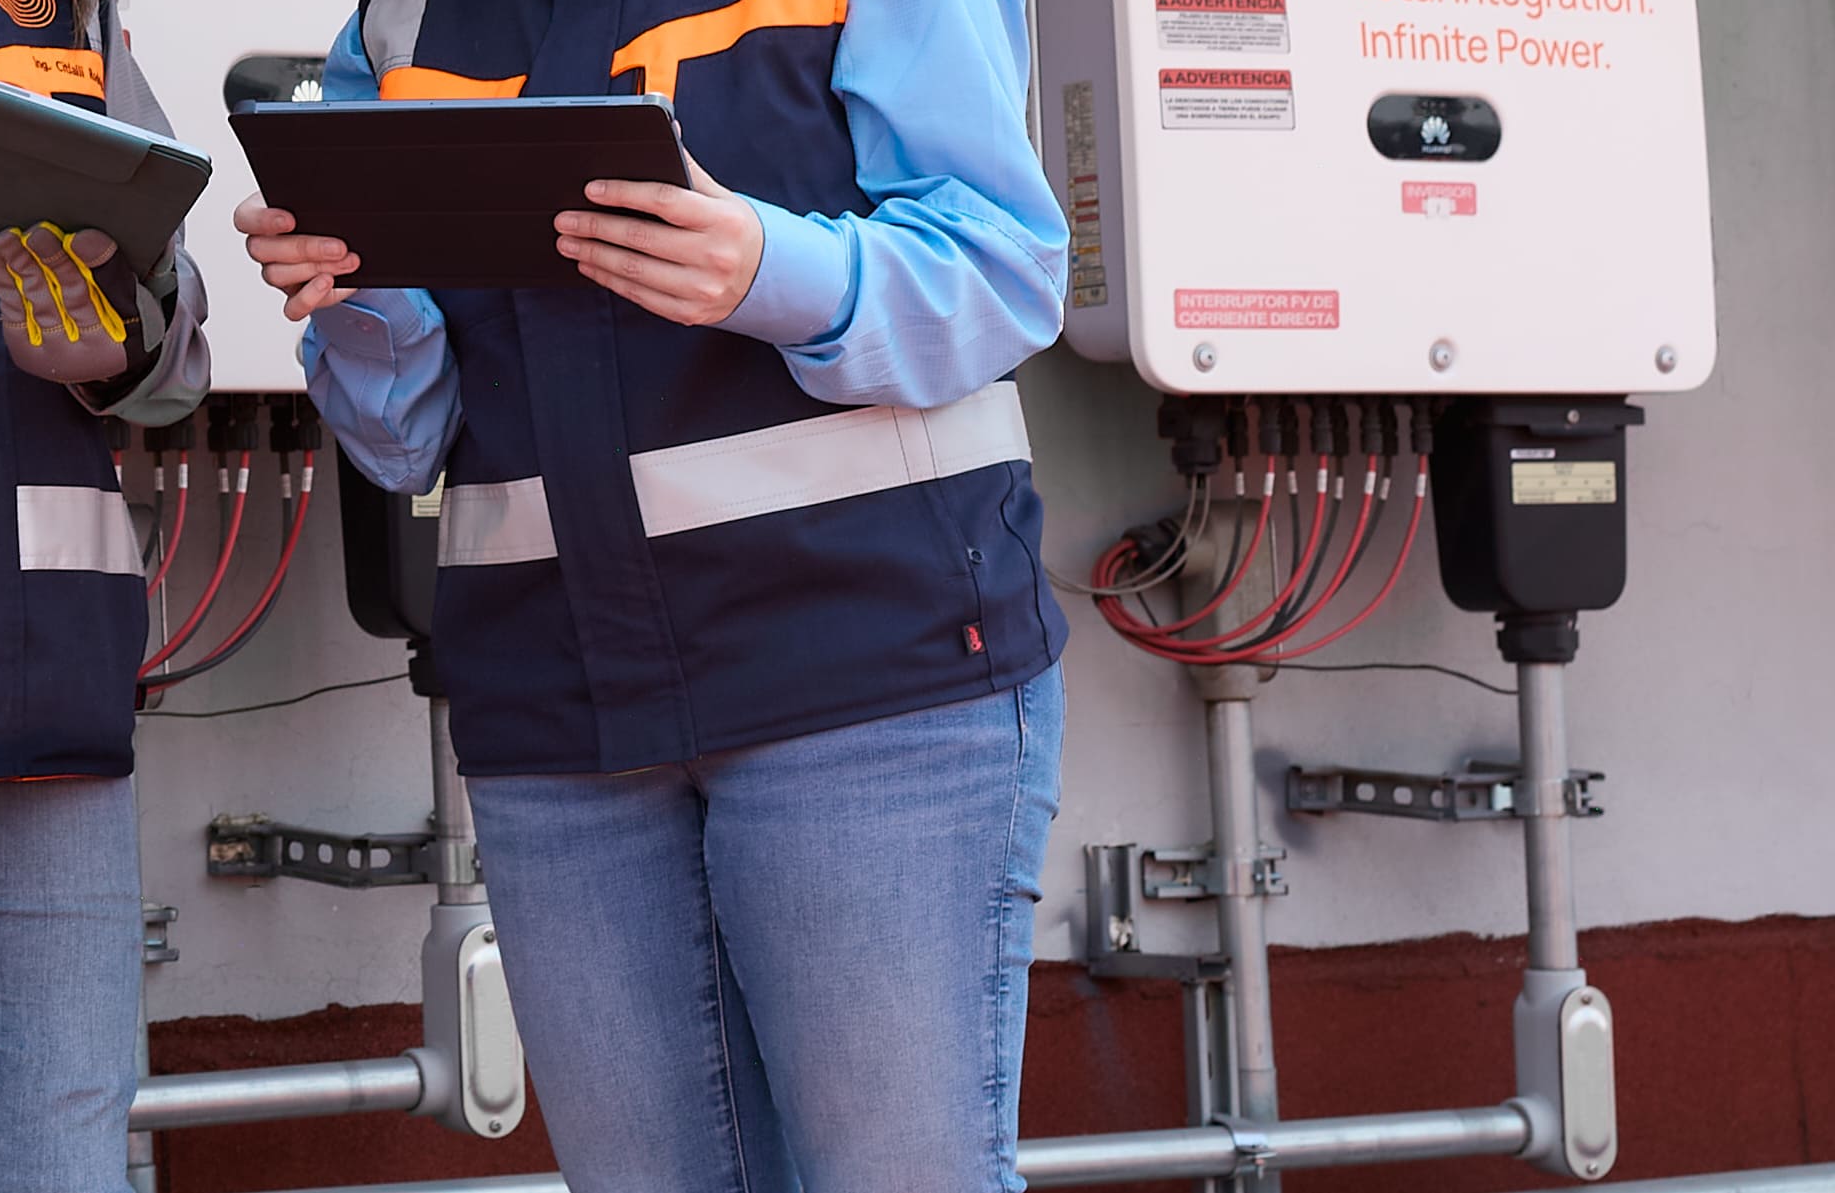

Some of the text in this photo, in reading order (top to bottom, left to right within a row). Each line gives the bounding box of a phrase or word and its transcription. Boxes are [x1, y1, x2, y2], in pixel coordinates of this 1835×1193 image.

[1361, 21, 1610, 69] Infinite Power.
[1175, 71, 1289, 85] ADVERTENCIA
[1180, 294, 1333, 308] INTERRUPTOR FV DE
[1179, 311, 1335, 326] CORRIENTE DIRECTA
